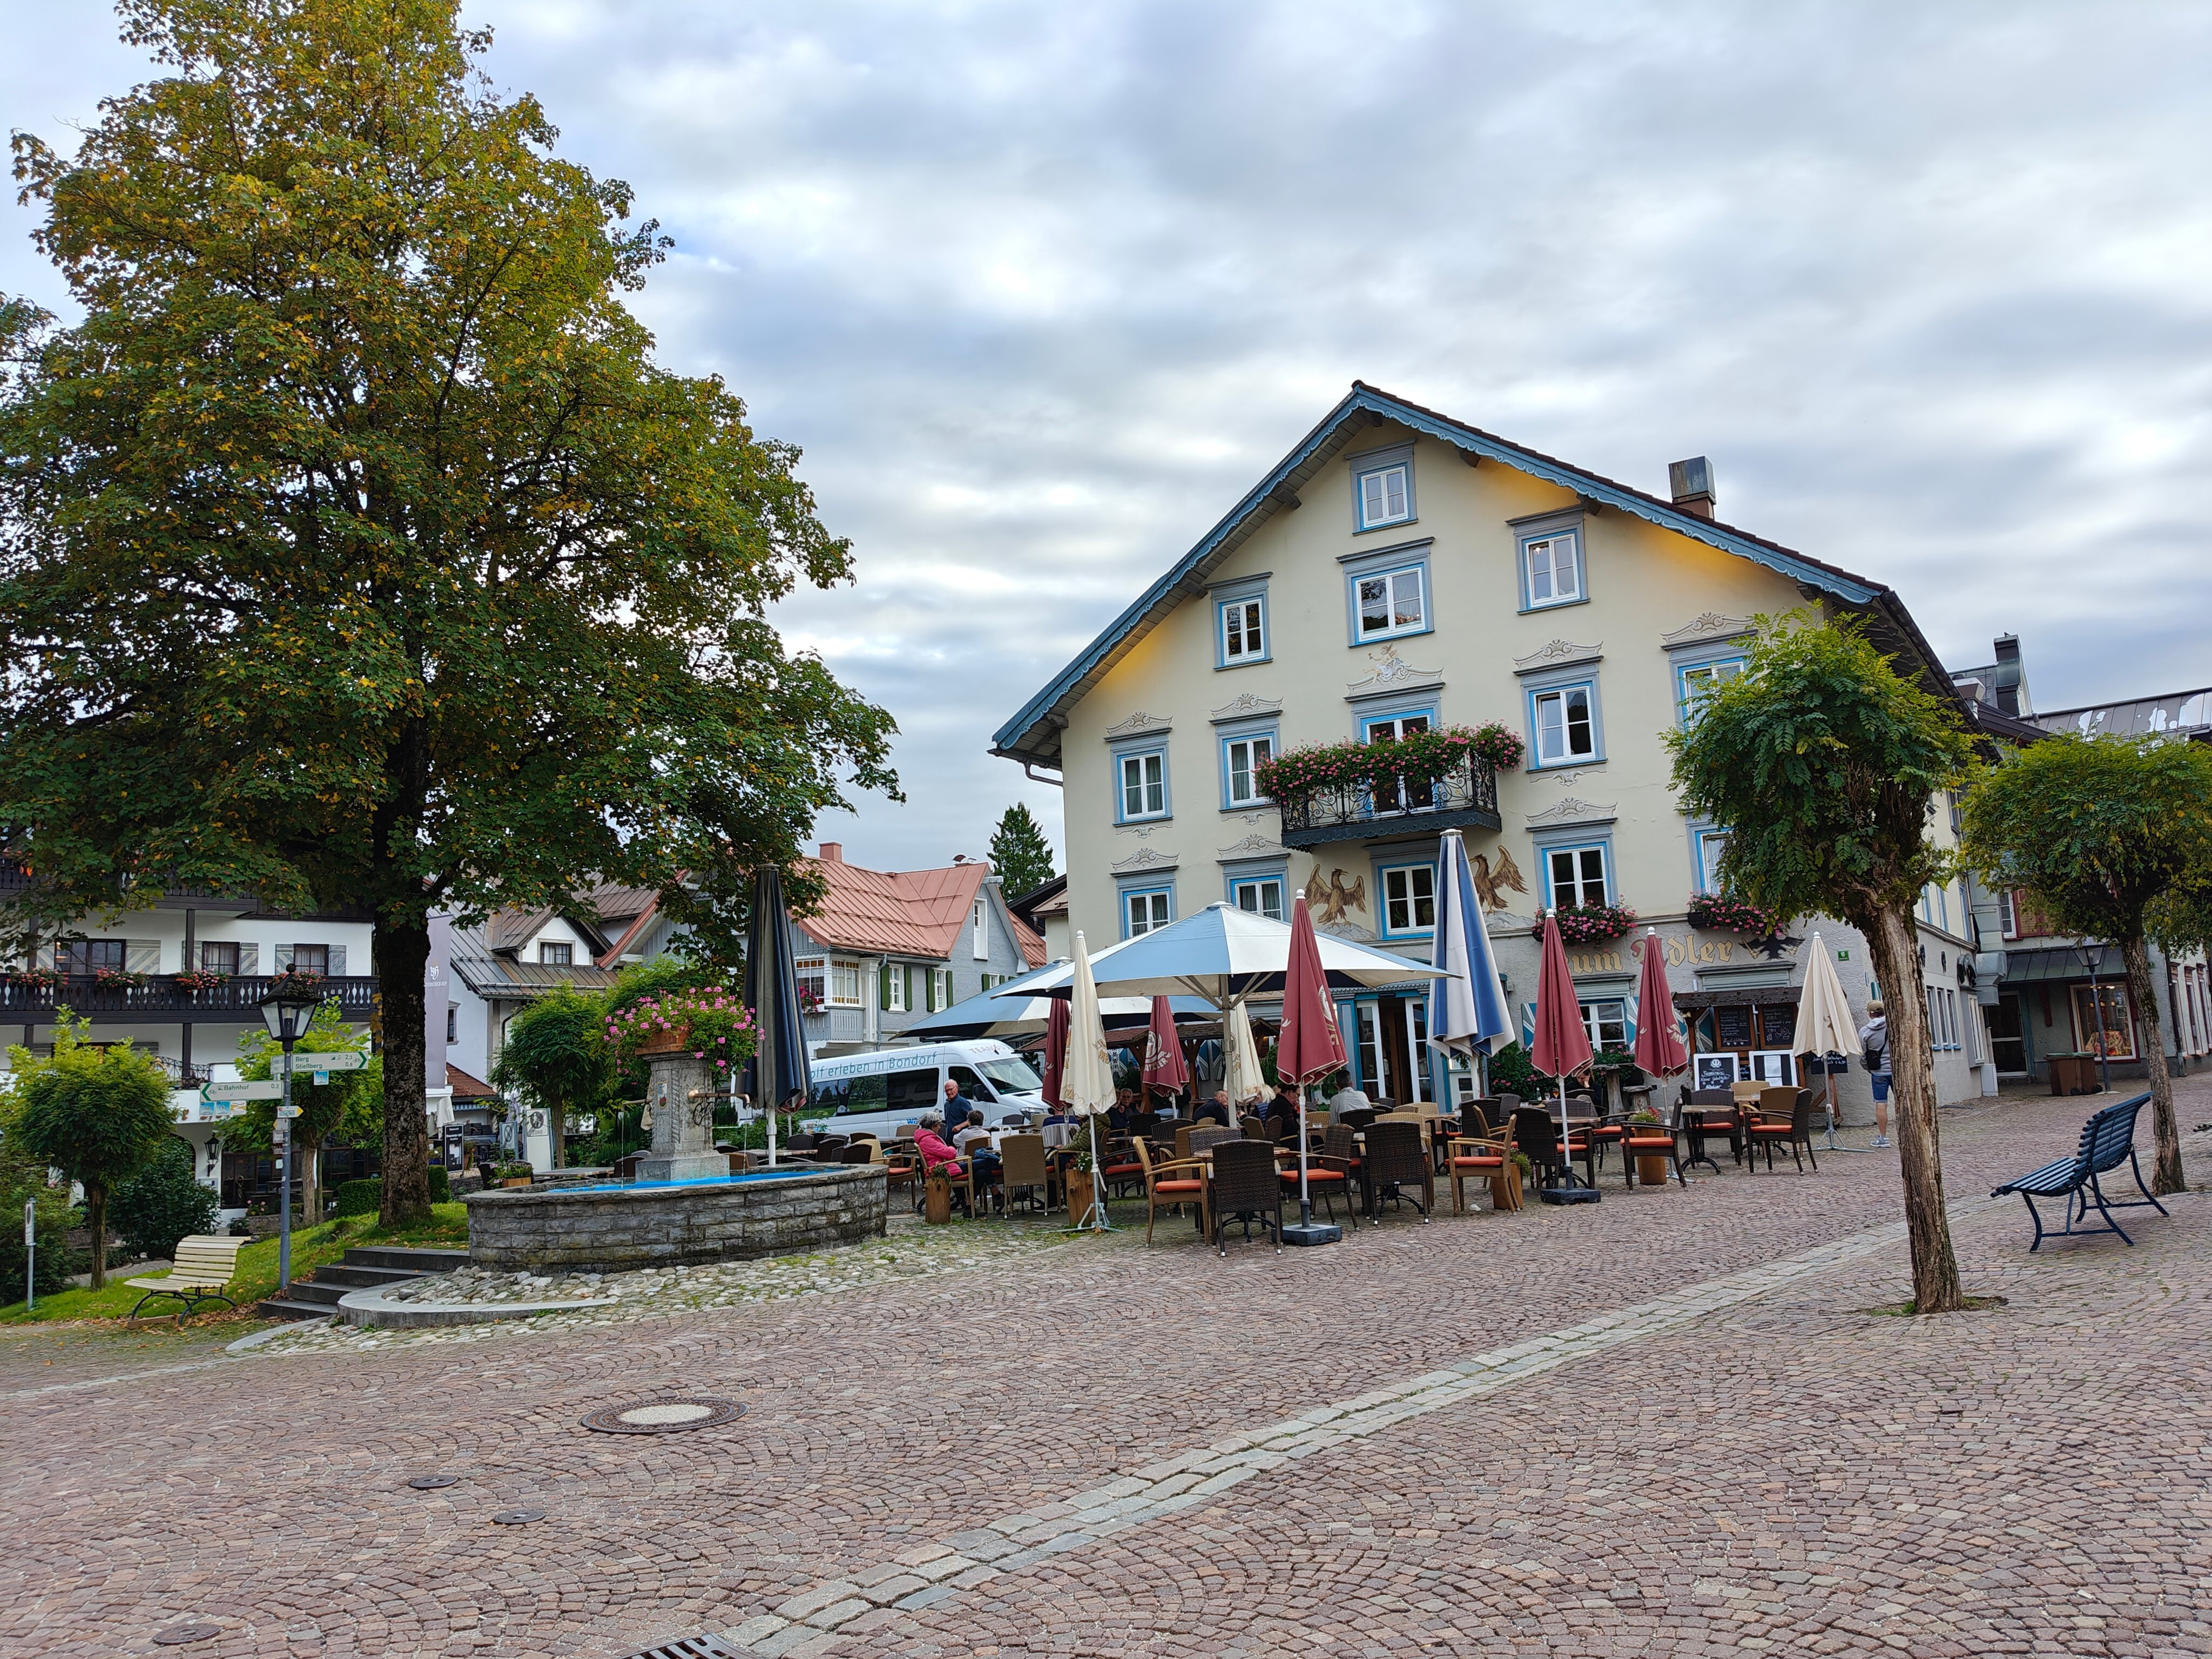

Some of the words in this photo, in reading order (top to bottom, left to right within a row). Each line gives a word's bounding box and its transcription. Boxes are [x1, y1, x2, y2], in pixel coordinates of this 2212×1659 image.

[1566, 952, 1623, 974] um
[811, 1065, 825, 1079] olf
[828, 1062, 869, 1076] erleben
[874, 1059, 884, 1070] in
[889, 1051, 937, 1069] Bondorf
